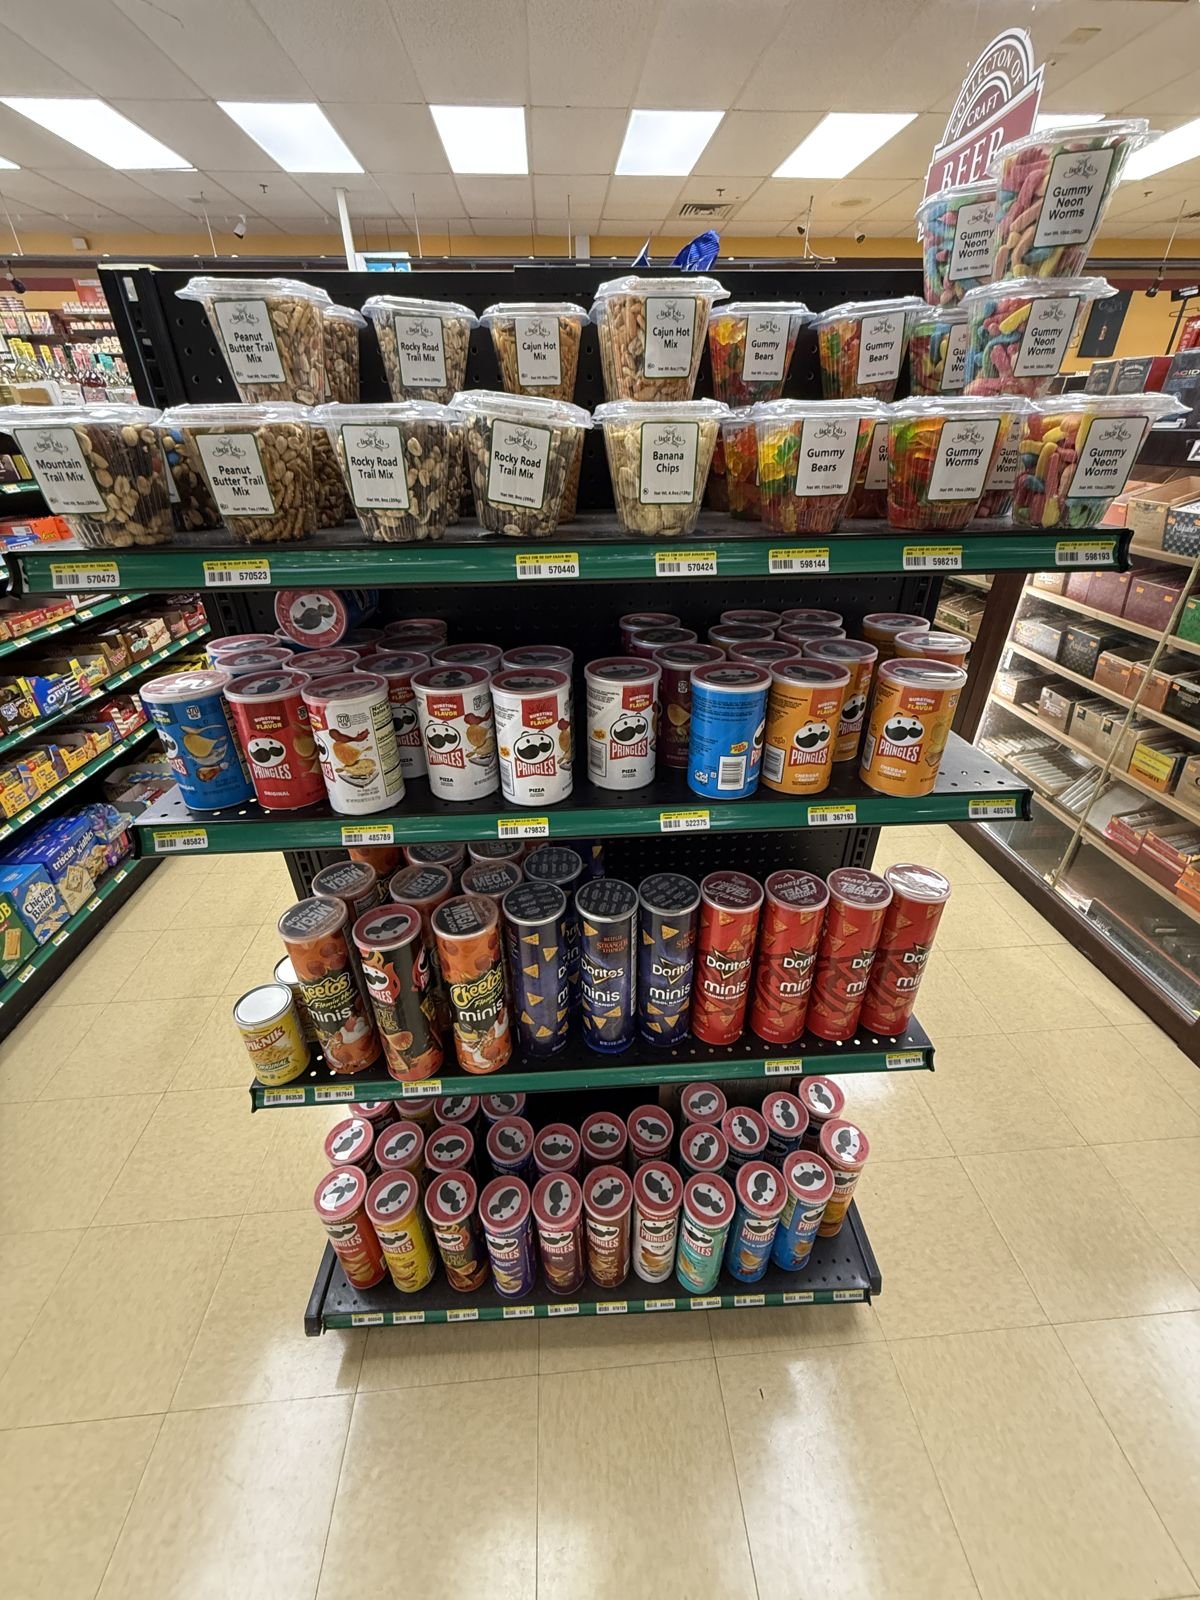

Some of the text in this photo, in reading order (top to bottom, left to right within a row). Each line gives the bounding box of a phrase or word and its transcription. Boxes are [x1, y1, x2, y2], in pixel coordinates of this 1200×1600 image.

[1010, 59, 1023, 86] OF
[966, 90, 1001, 127] CRAFT
[1053, 184, 1093, 199] Gummy
[1056, 197, 1084, 208] Neon
[1049, 208, 1085, 220] Worms
[960, 227, 995, 241] Gummy
[964, 238, 987, 249] Neon
[958, 247, 989, 259] Worms
[234, 332, 263, 342] Peanut
[652, 326, 690, 338] Cajun Hot
[1031, 327, 1063, 338] Gummy
[522, 341, 556, 352] Cajun Hot
[664, 339, 678, 349] Mix
[751, 339, 780, 350] Gummy
[865, 340, 895, 352] Gummy
[1033, 337, 1056, 346] Neon
[228, 342, 275, 353] Butter Trail
[400, 342, 440, 354] Rocky Road
[1027, 346, 1056, 357] Worms
[246, 354, 263, 363] Mix
[406, 352, 436, 362] Trail Mix
[533, 352, 547, 361] Mix
[754, 352, 774, 361] Bears
[869, 352, 889, 363] Bears
[652, 451, 684, 461] Banana
[807, 447, 846, 459] Gummy
[945, 447, 984, 458] Gummy
[999, 448, 1018, 456] Gum
[1089, 447, 1127, 459] Gummy
[36, 458, 82, 470] Mountain
[350, 456, 398, 469] Rocky Road
[494, 451, 541, 468] Rocky Road
[945, 456, 979, 467] Worms
[1002, 456, 1017, 465] Neo
[1092, 457, 1118, 466] Neon
[218, 465, 251, 475] Peanut
[499, 464, 534, 479] Trail Mix
[656, 463, 680, 474] Chips
[811, 462, 837, 472] Bears
[996, 464, 1017, 473] Worm
[1084, 466, 1118, 476] Worms
[43, 472, 86, 483] Trail Mix
[358, 469, 394, 480] Trail Mix
[212, 475, 264, 486] Butter Trail
[232, 486, 250, 496] Mix
[932, 557, 959, 566] 598219
[1084, 552, 1110, 561] 598193
[548, 564, 576, 574] 570440
[687, 562, 714, 572] 570424
[800, 559, 826, 568] 598144
[86, 574, 116, 584] 570473
[239, 571, 268, 581] 570523
[907, 703, 933, 711] FLAVOR
[255, 722, 282, 730] FLAVOR
[611, 740, 647, 758] PRINGLES
[878, 738, 920, 762] PRINGLES
[428, 749, 463, 767] PRINGLES
[790, 748, 828, 765] PRINGLES
[252, 763, 292, 780] PRINGLES
[516, 758, 556, 776] PRINGLES
[832, 812, 854, 821] 367193
[685, 819, 707, 827] 522375
[523, 826, 546, 835] 479832
[182, 837, 205, 846] 485821
[368, 833, 391, 842] 485789
[52, 846, 76, 871] triscuit
[324, 867, 365, 890] MEGA
[405, 873, 439, 895] MEGA
[472, 871, 512, 888] MEGA
[25, 885, 54, 914] Chicken
[32, 895, 55, 920] Biskit
[291, 903, 334, 931] MEGA
[450, 902, 478, 930] MEGA
[581, 959, 624, 978] Doritos
[652, 958, 694, 977] Doritos
[706, 955, 751, 971] Doritos
[581, 981, 620, 1002] minis
[649, 983, 691, 1000] minis
[703, 980, 747, 995] minis
[459, 998, 503, 1022] minis
[640, 1228, 674, 1242] PRINGLES
